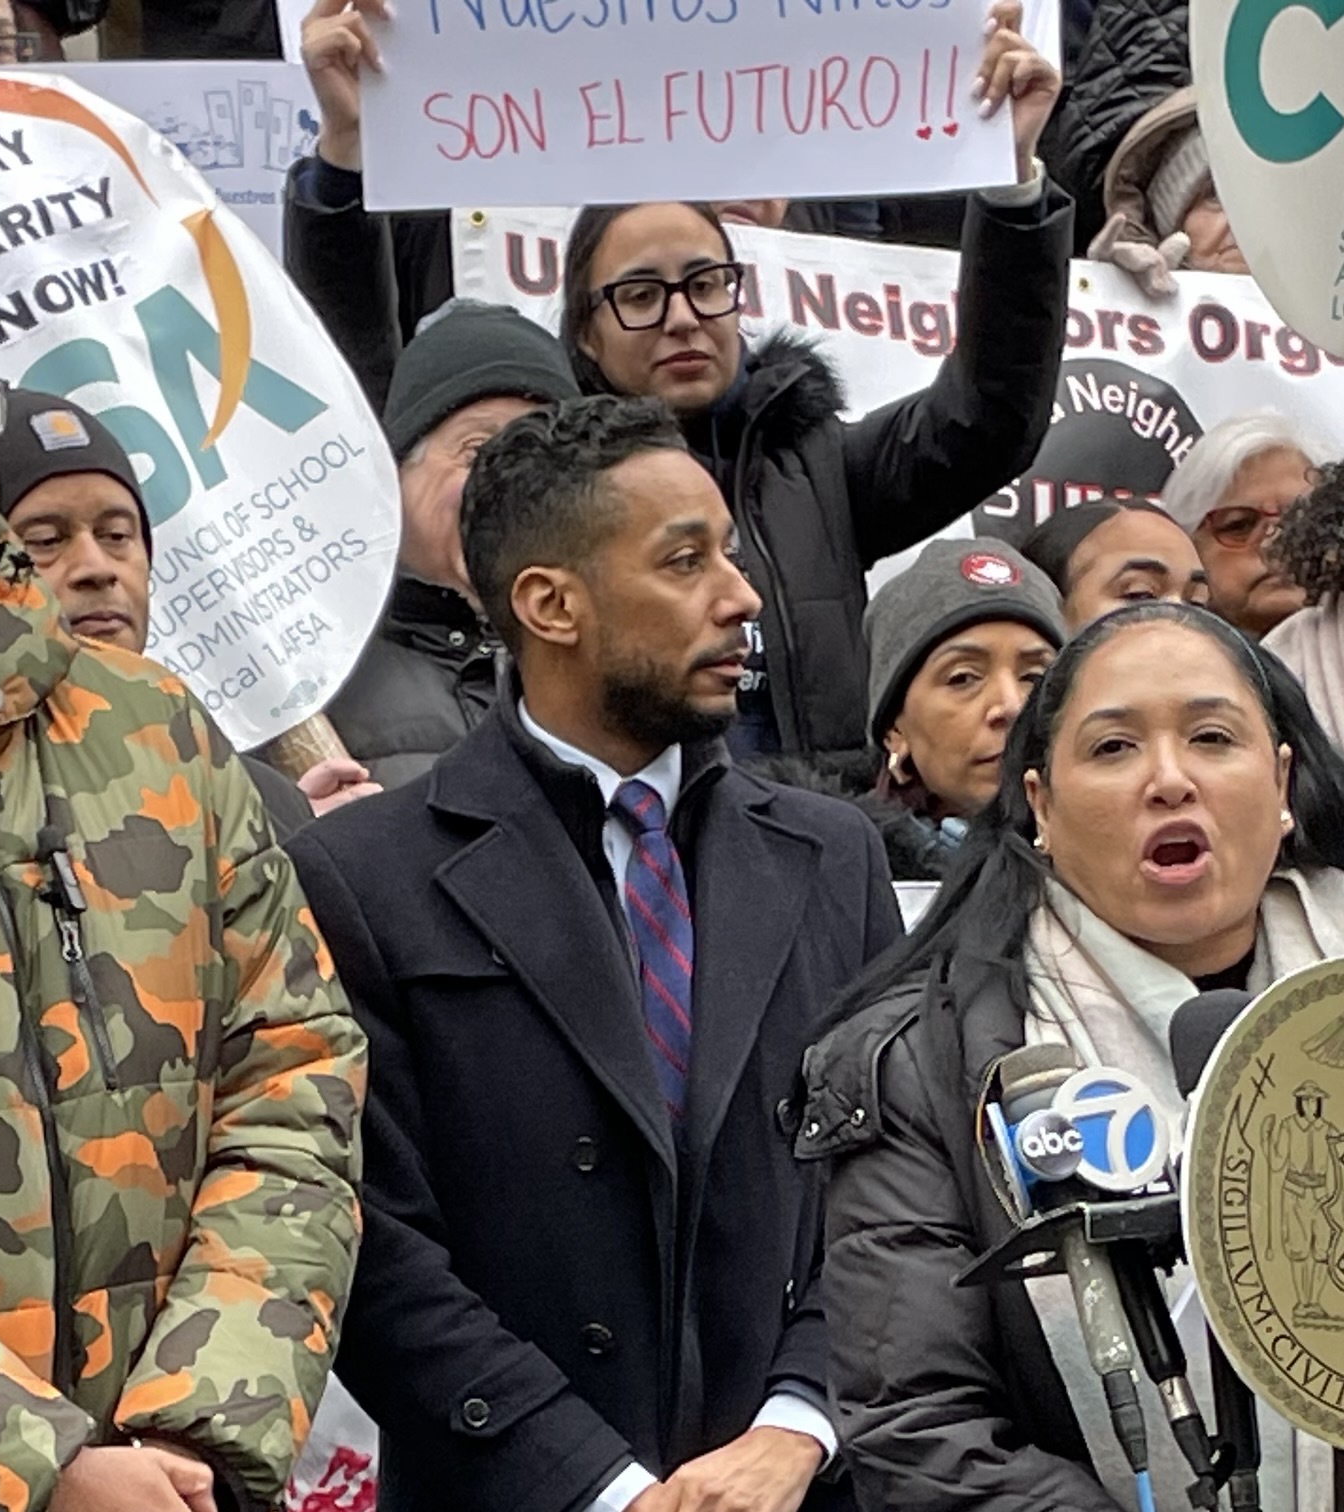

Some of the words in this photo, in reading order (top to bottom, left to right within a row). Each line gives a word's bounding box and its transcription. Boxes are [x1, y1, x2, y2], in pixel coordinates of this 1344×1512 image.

[424, 88, 547, 162] SON
[580, 79, 644, 148] EL
[222, 503, 253, 539] OF
[250, 433, 366, 520] SCHOOL
[292, 514, 321, 543] &
[163, 528, 368, 677] ADMINISTRATORS
[1022, 1126, 1085, 1159] abc
